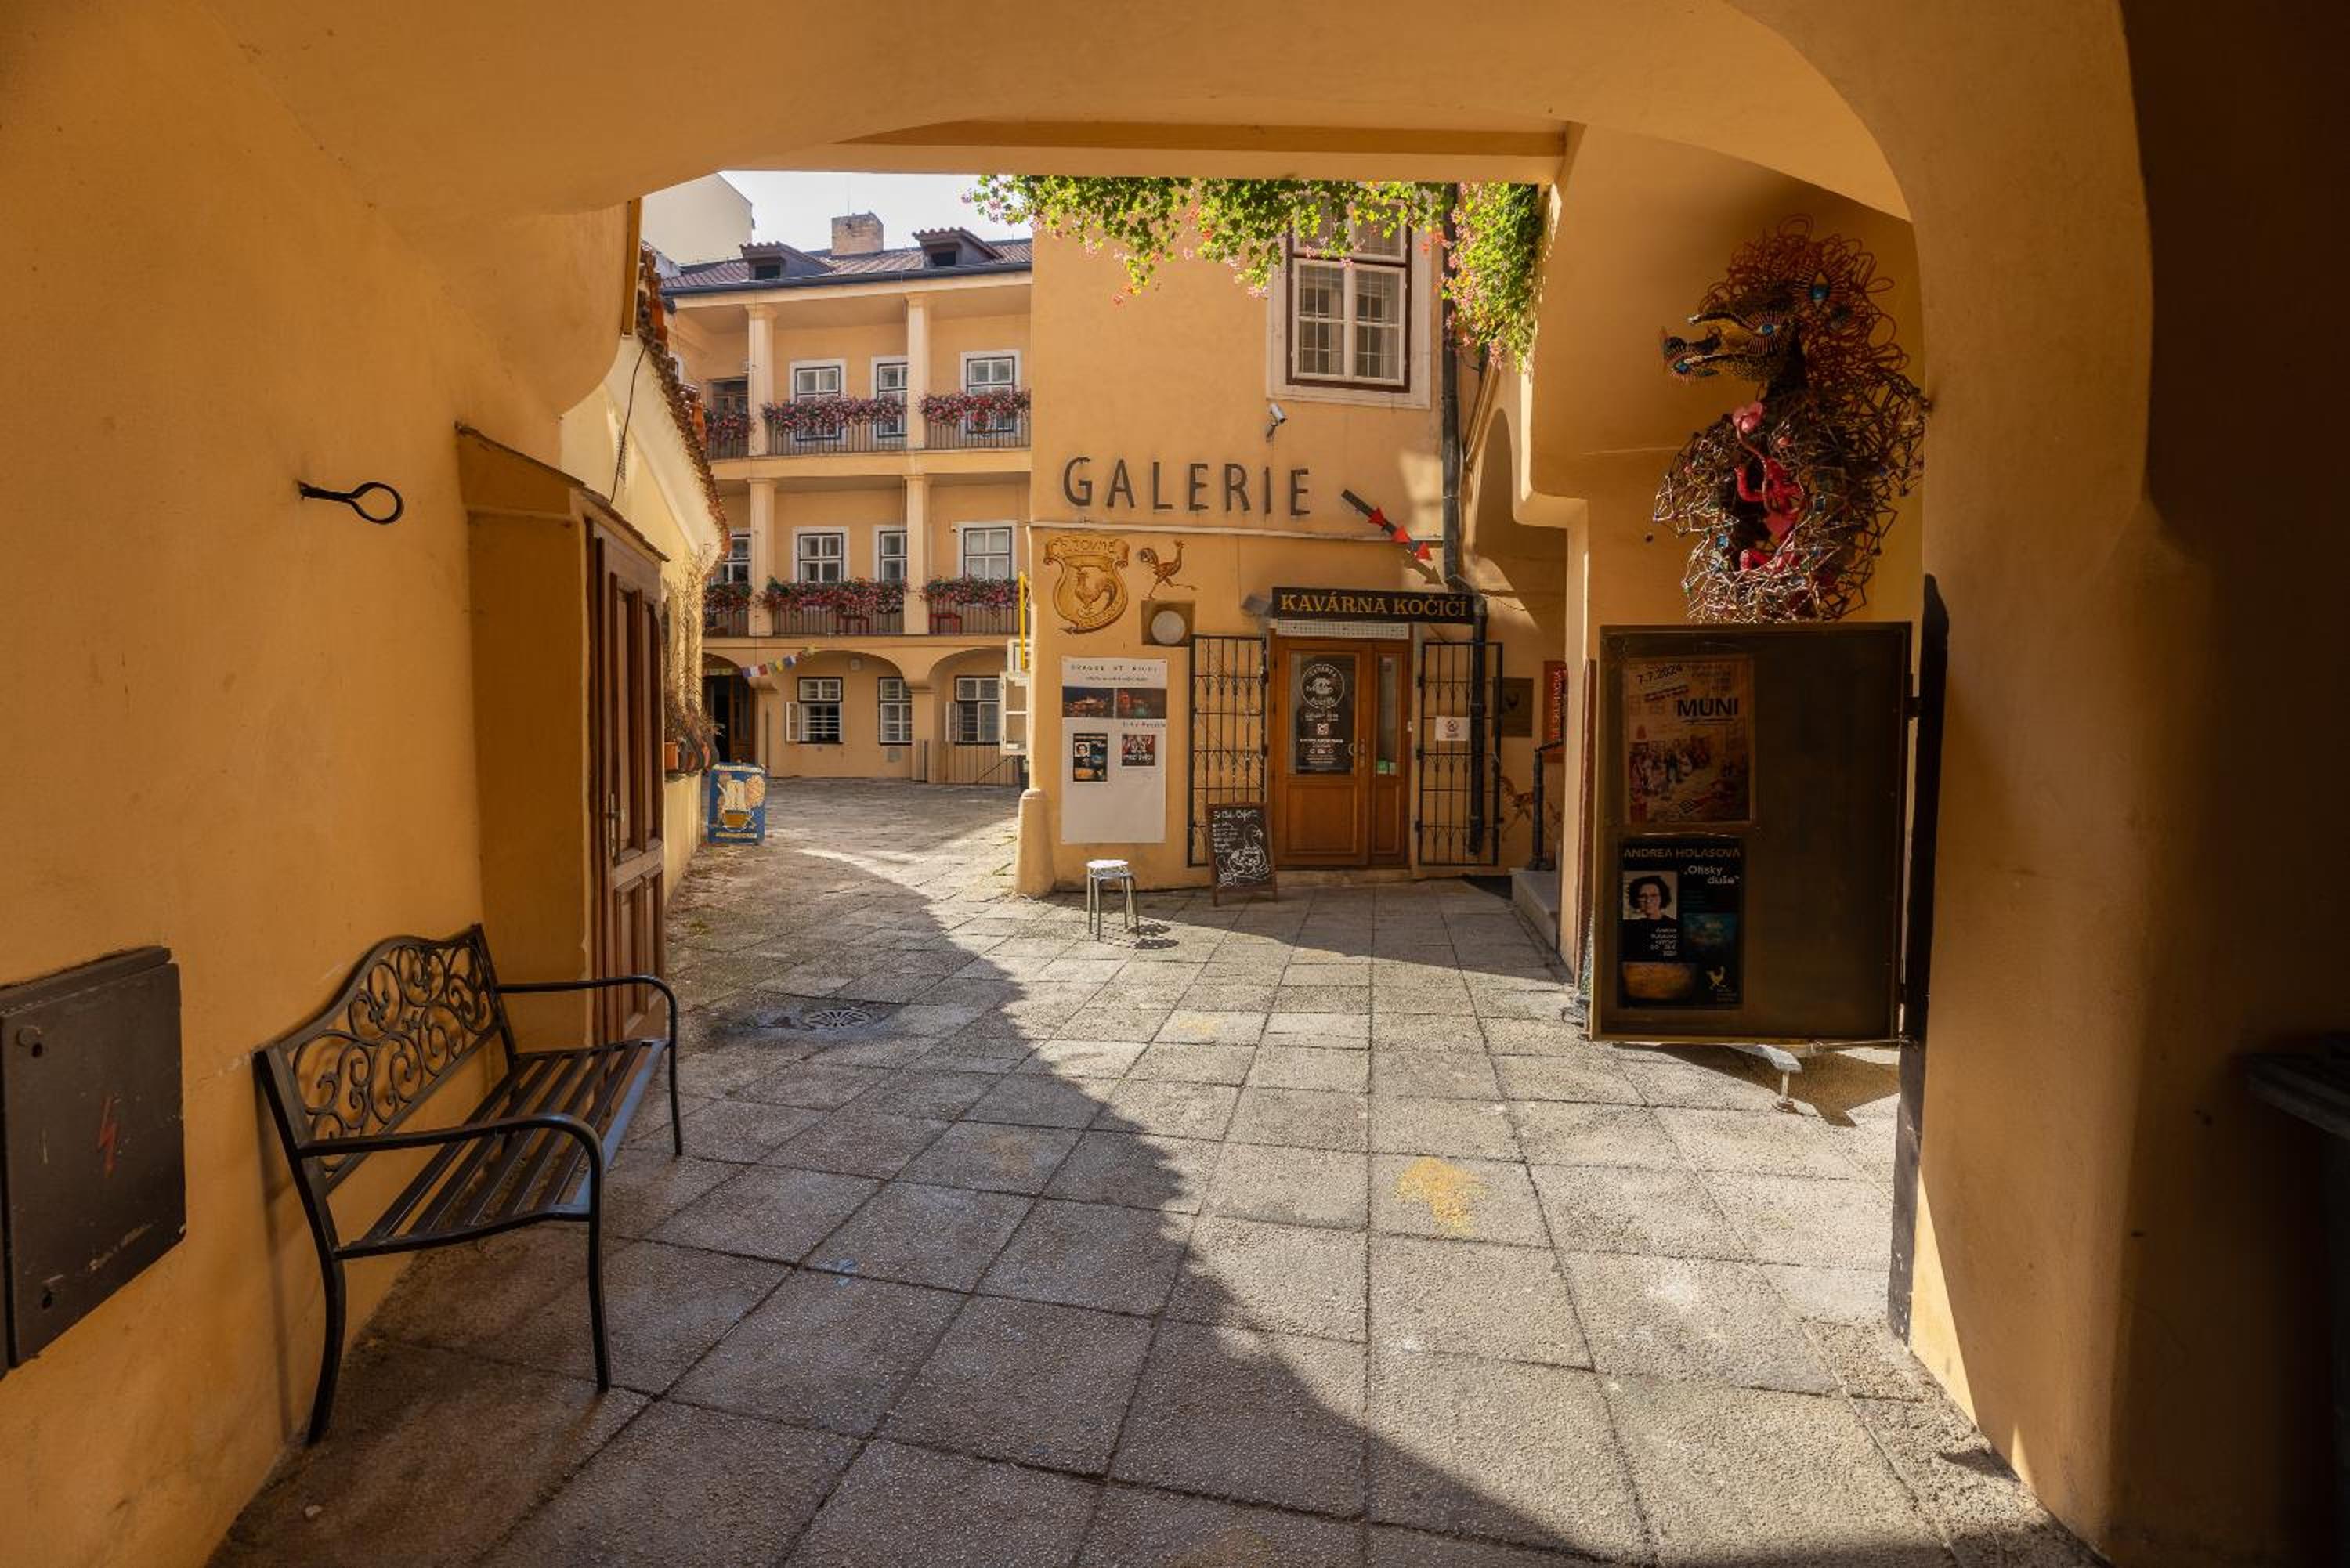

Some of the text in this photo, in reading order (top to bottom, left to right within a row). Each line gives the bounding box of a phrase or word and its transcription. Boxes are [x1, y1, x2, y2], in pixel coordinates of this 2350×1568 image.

[1063, 457, 1311, 516] GALERIE
[1280, 591, 1467, 616] KAVÁRNA KOČIČÍ
[1624, 847, 1672, 858] ANDREA
